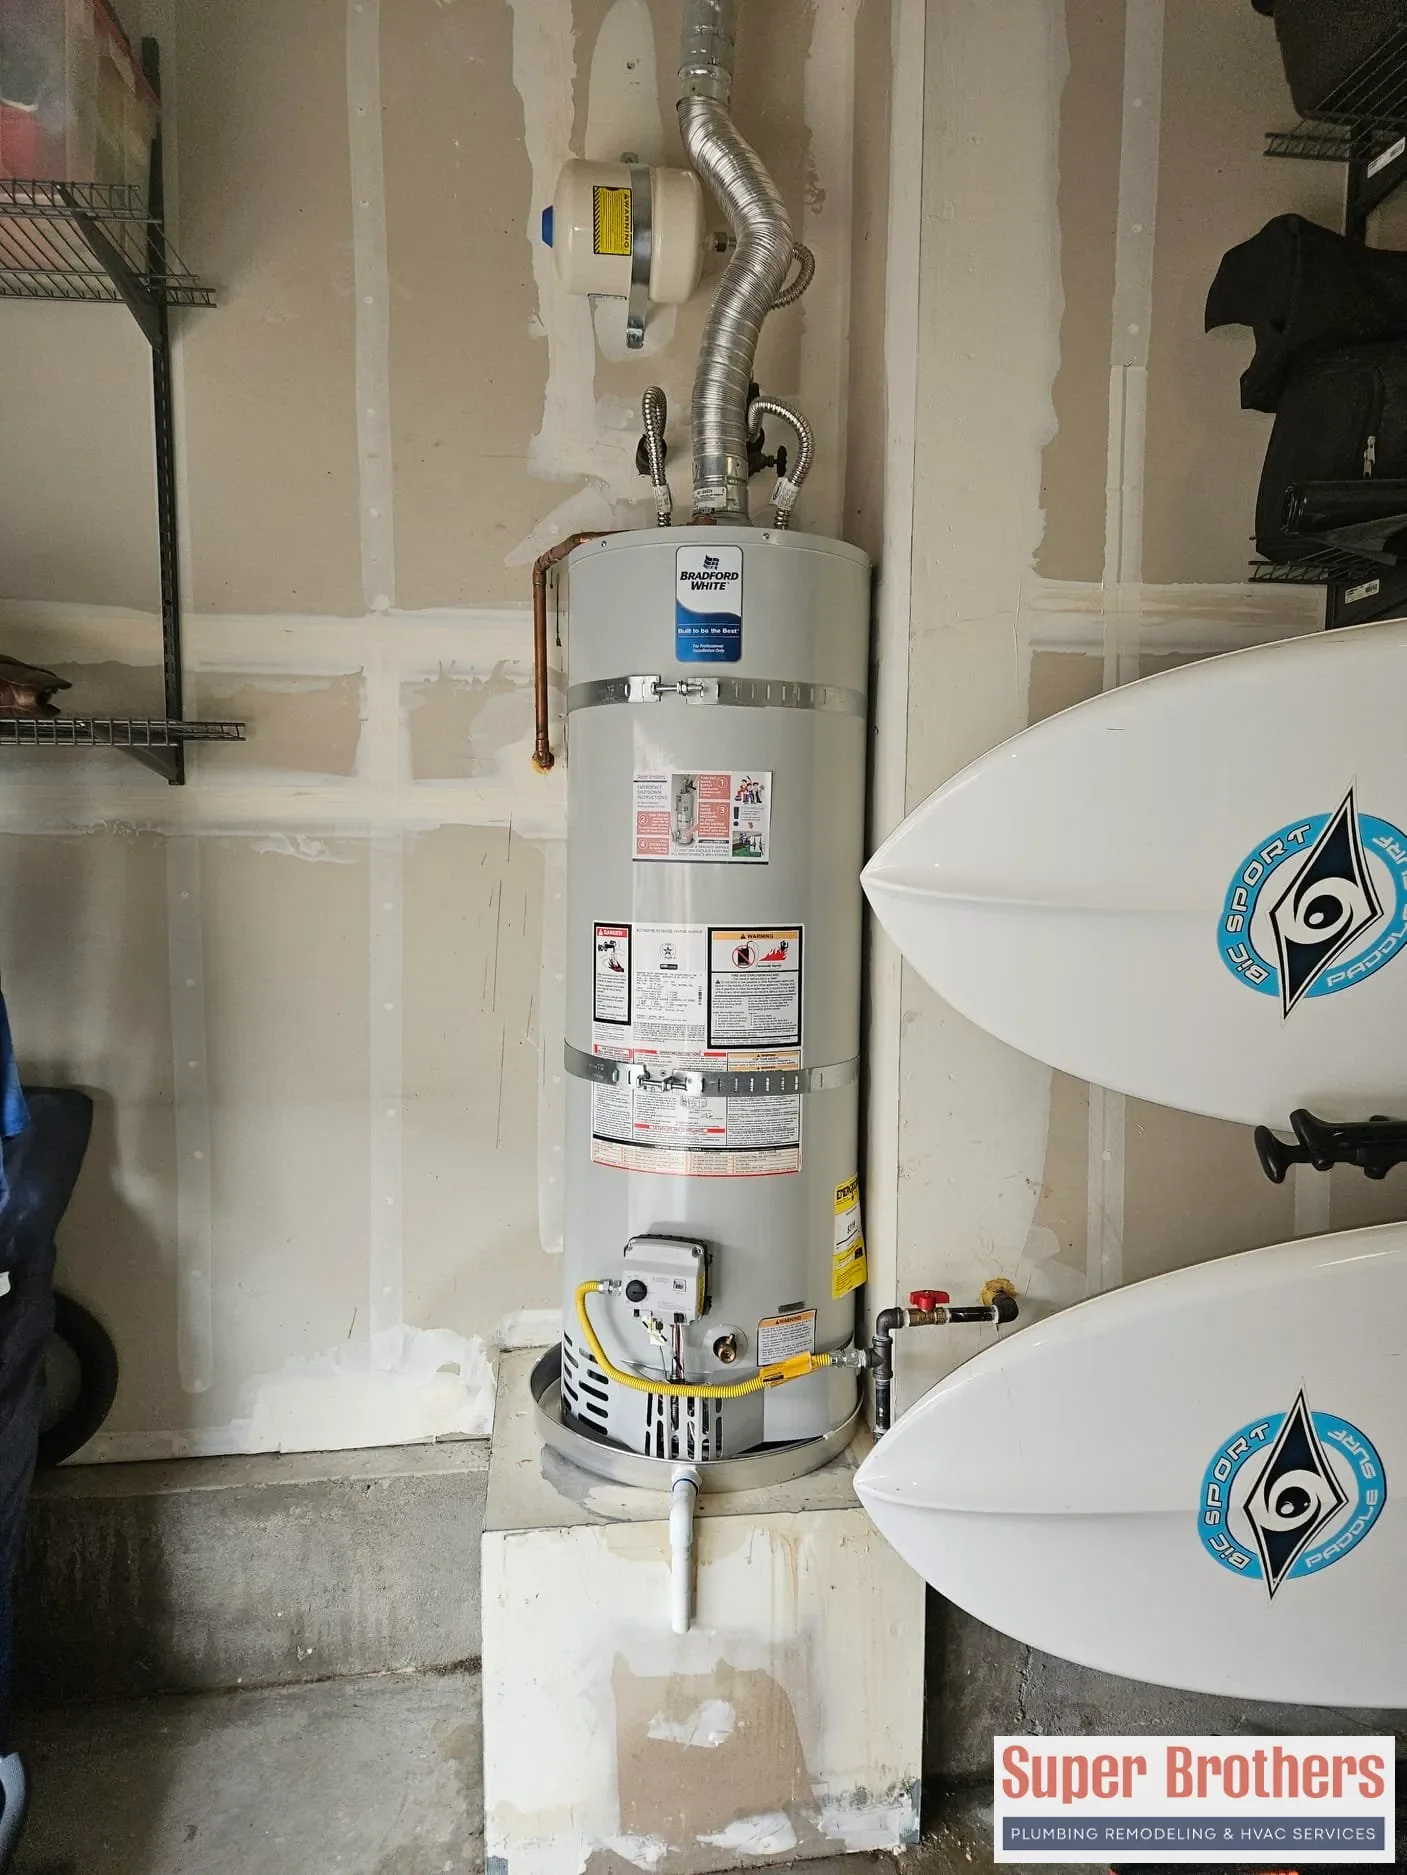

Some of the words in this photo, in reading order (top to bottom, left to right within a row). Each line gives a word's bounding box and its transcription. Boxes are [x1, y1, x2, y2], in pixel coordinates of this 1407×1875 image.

[680, 571, 739, 581] BRADFORD
[691, 581, 727, 591] WHITE
[1225, 823, 1311, 933] SPORT
[780, 1315, 801, 1324] WARNING
[1204, 1422, 1270, 1526] SPORT
[1327, 1429, 1377, 1479] SURF
[1304, 1489, 1378, 1568] PADDLE
